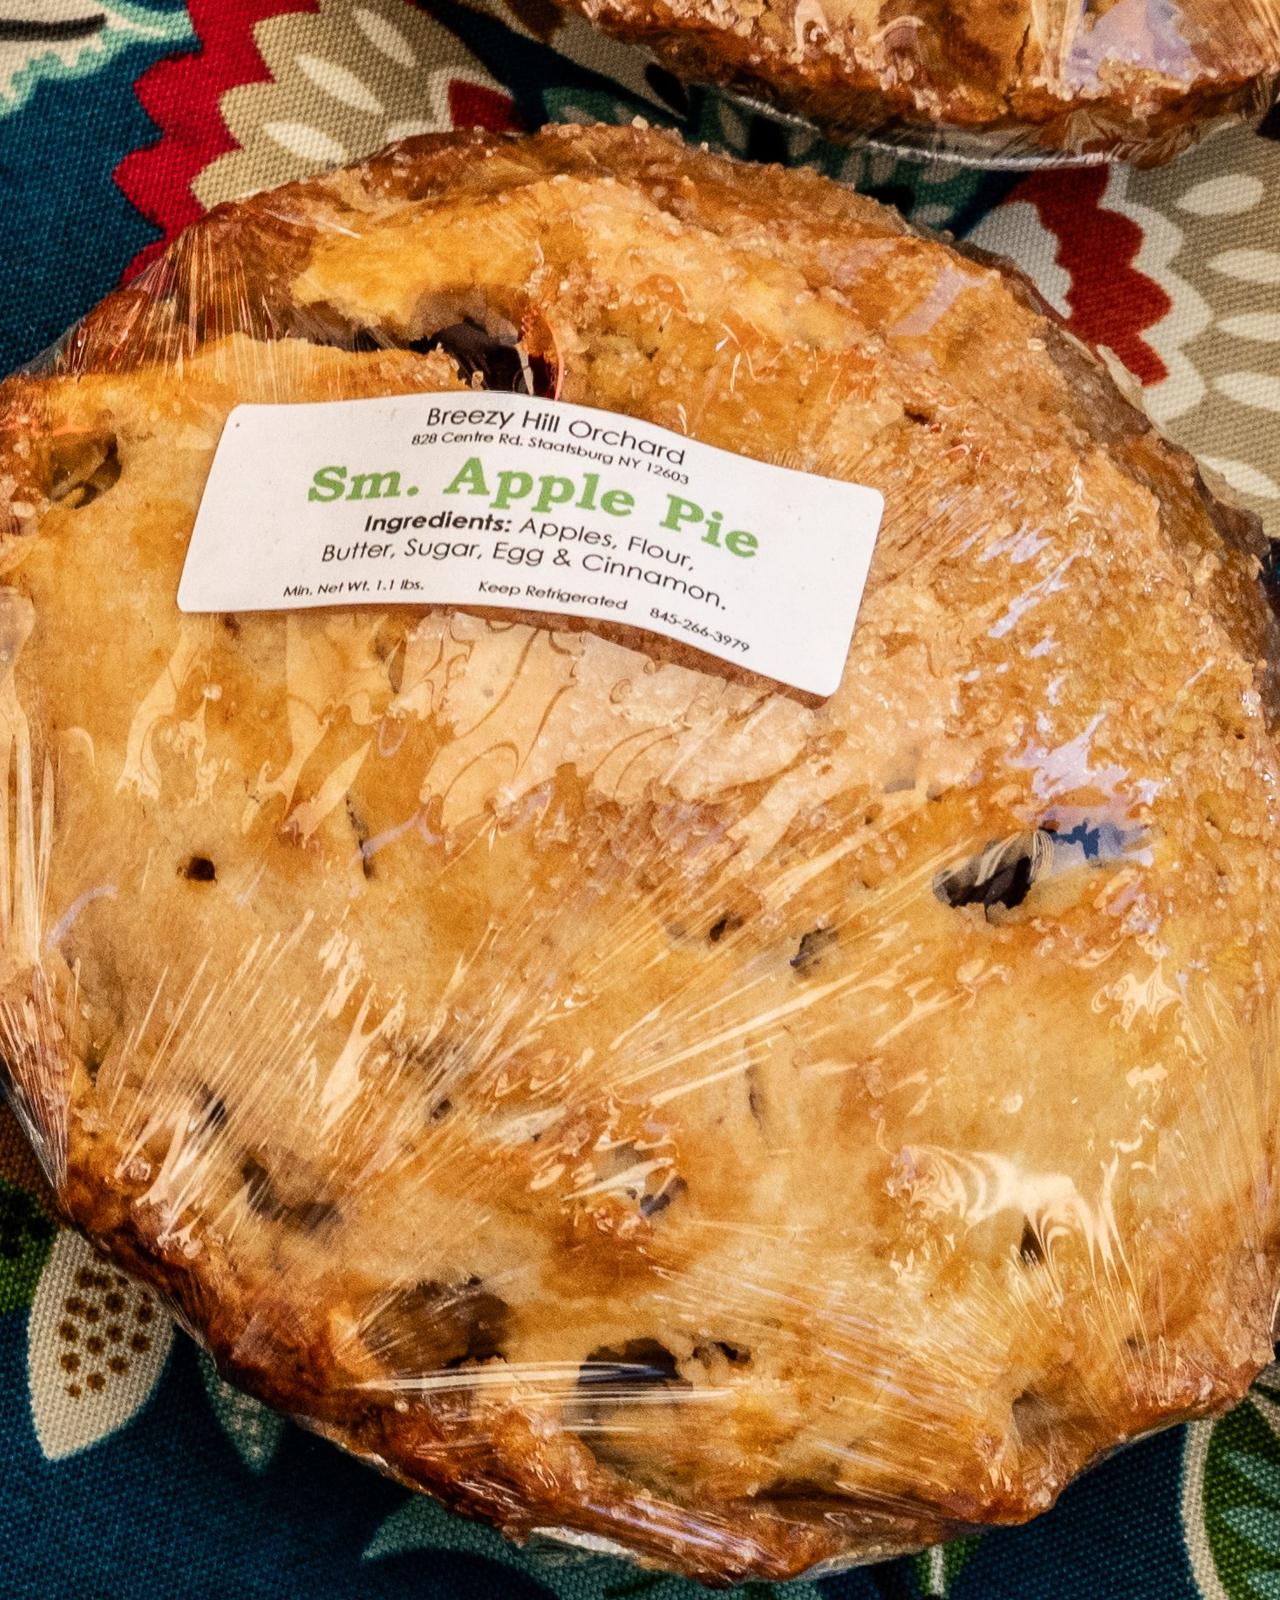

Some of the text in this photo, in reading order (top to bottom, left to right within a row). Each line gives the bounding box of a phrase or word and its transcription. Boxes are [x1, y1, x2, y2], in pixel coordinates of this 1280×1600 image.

[411, 433, 438, 446] 828
[441, 430, 494, 444] Centre
[528, 436, 613, 465] Staatsburg
[619, 456, 641, 468] NY
[647, 462, 689, 485] 12603
[426, 407, 686, 466] Breezy Hill Orchard
[308, 455, 760, 558] Sm. Apple Pie
[364, 510, 694, 571] Ingredients: Apples, Flour,
[317, 581, 344, 595] Net
[376, 579, 395, 591] 1.1
[478, 580, 629, 611] Keep Refrigerated
[492, 541, 545, 567] Egg
[552, 548, 571, 567] &
[581, 553, 726, 611] Cinnamon.
[649, 607, 750, 653] 845-266-3979
